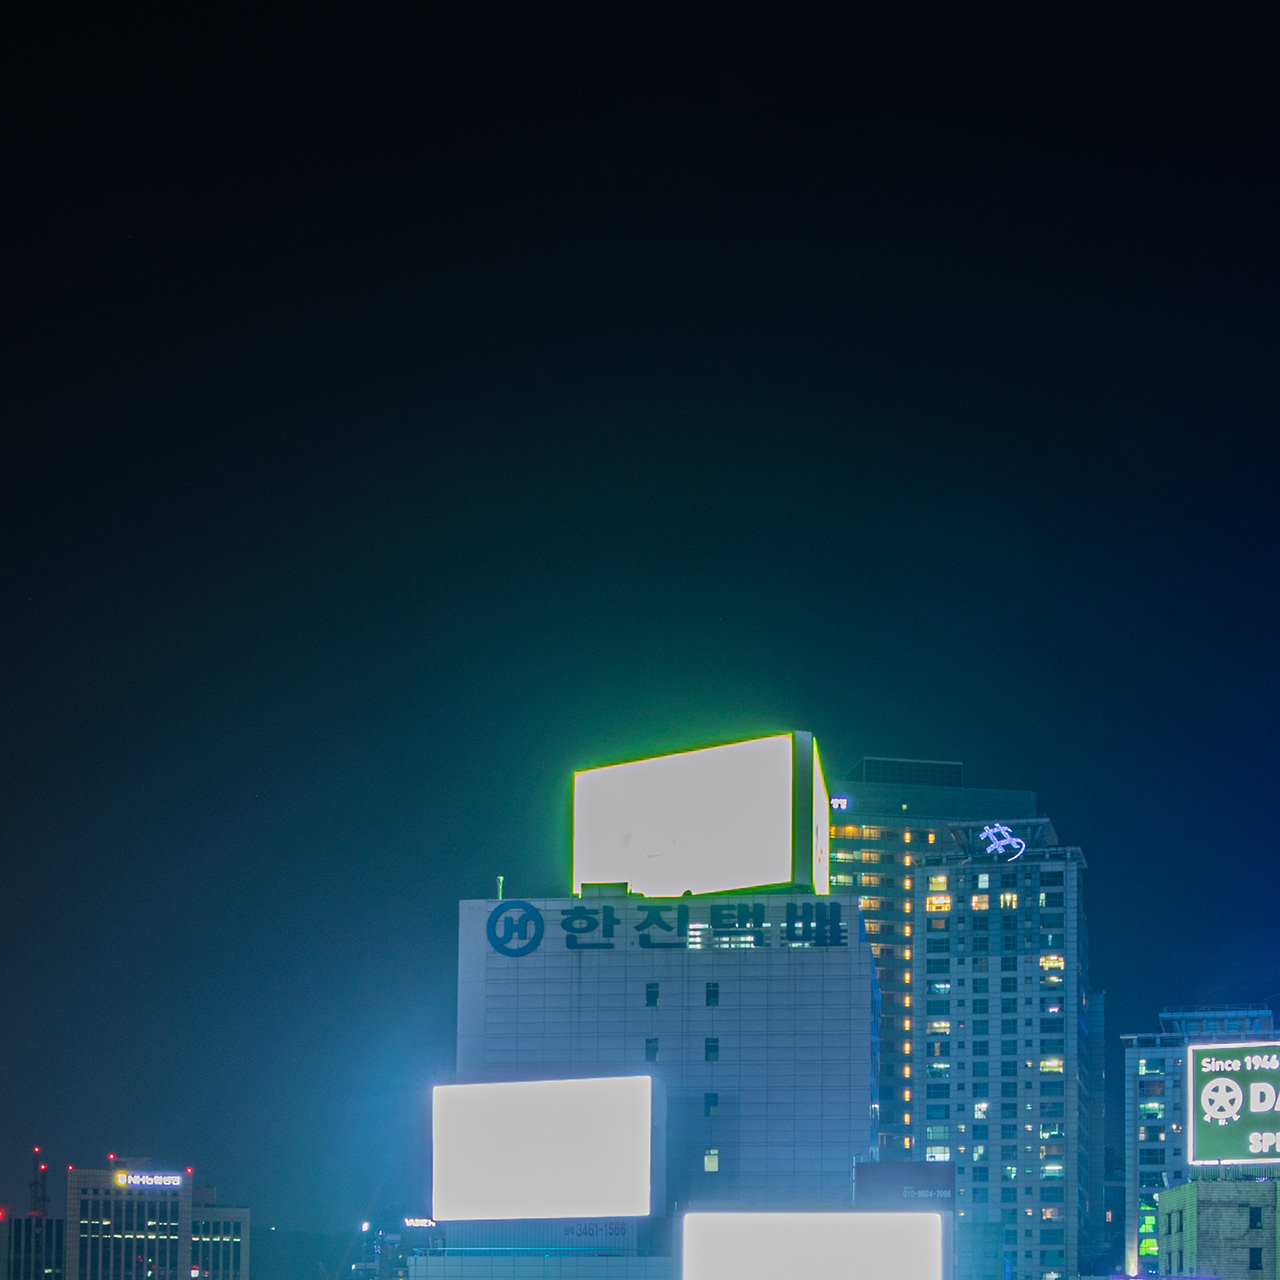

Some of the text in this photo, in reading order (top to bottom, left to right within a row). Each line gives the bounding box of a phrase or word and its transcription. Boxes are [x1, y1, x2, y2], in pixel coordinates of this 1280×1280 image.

[561, 903, 848, 950] 한진택배
[1201, 1056, 1242, 1073] Since
[576, 1221, 627, 1239] 3461-1566
